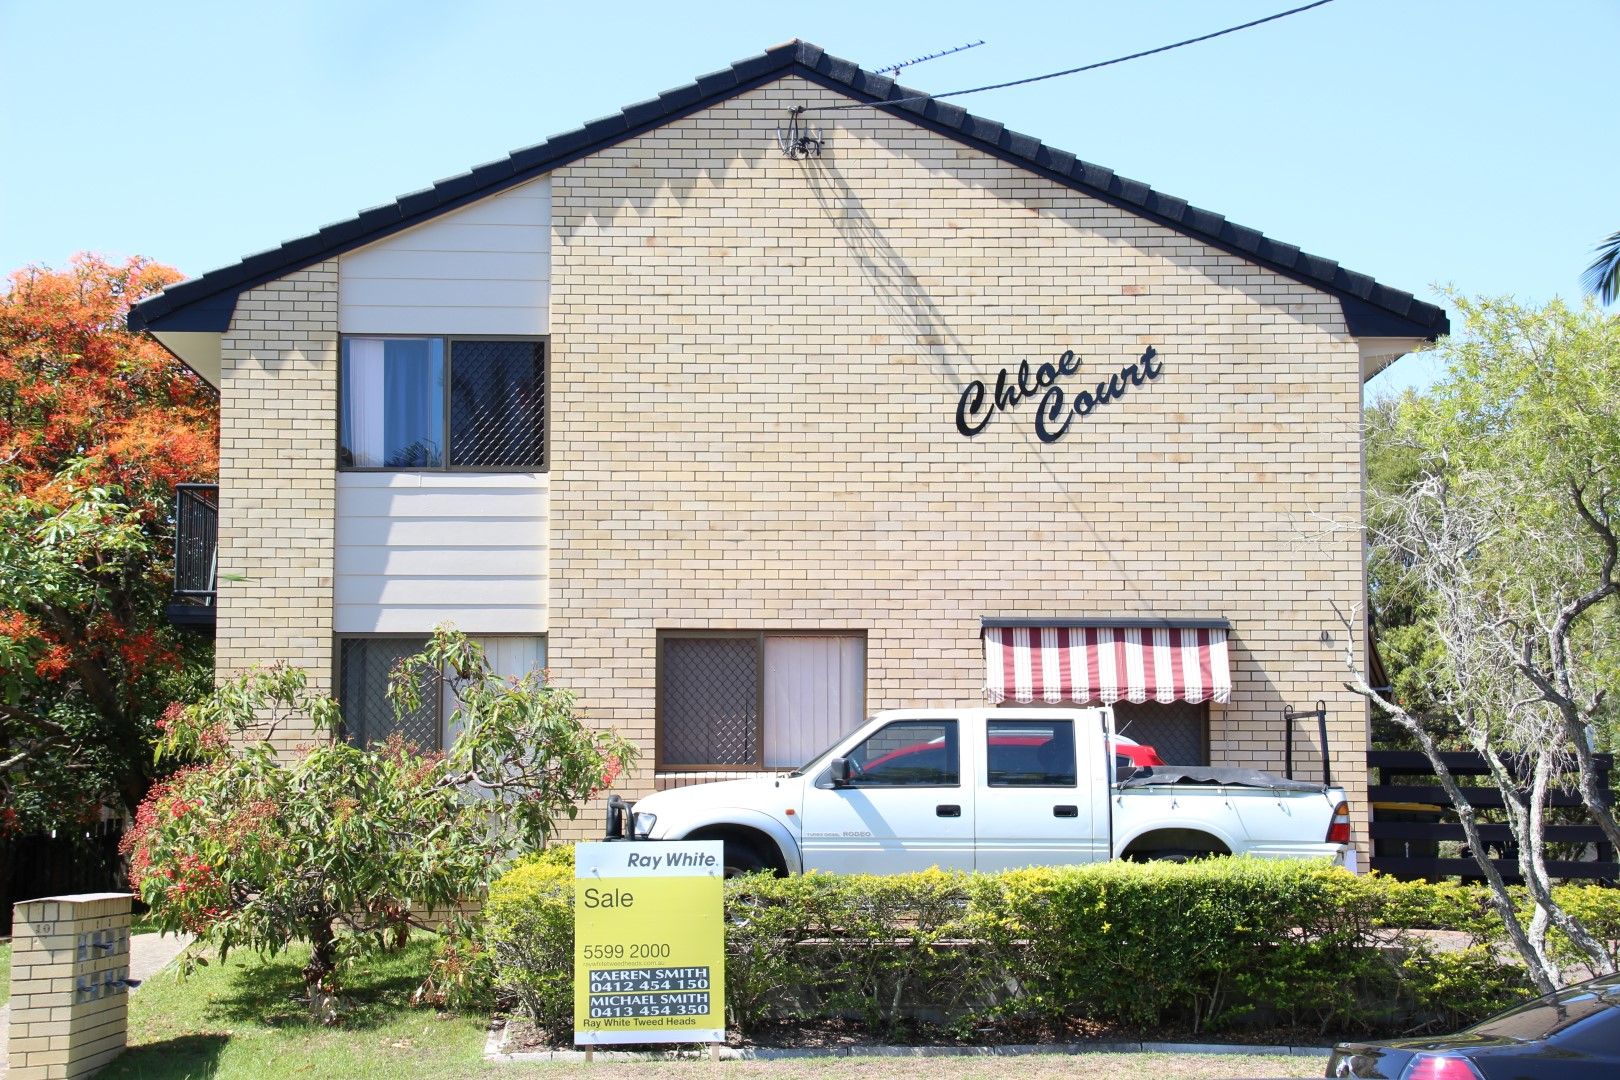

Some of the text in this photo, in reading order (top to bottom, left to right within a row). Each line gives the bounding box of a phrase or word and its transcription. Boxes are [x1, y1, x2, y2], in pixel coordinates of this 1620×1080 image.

[956, 350, 1081, 436] Chloe
[1035, 345, 1162, 443] Court
[627, 852, 662, 870] Ray
[584, 888, 634, 909] Sale
[583, 943, 670, 959] 5599 2000
[591, 968, 707, 982] KAEREN SMITH
[591, 979, 709, 993] 0412 454 150
[591, 993, 708, 1006] MICHAEL SMITH
[591, 1004, 709, 1018] 0413 454 350
[583, 1016, 697, 1029] Ray White Tweed Heads
